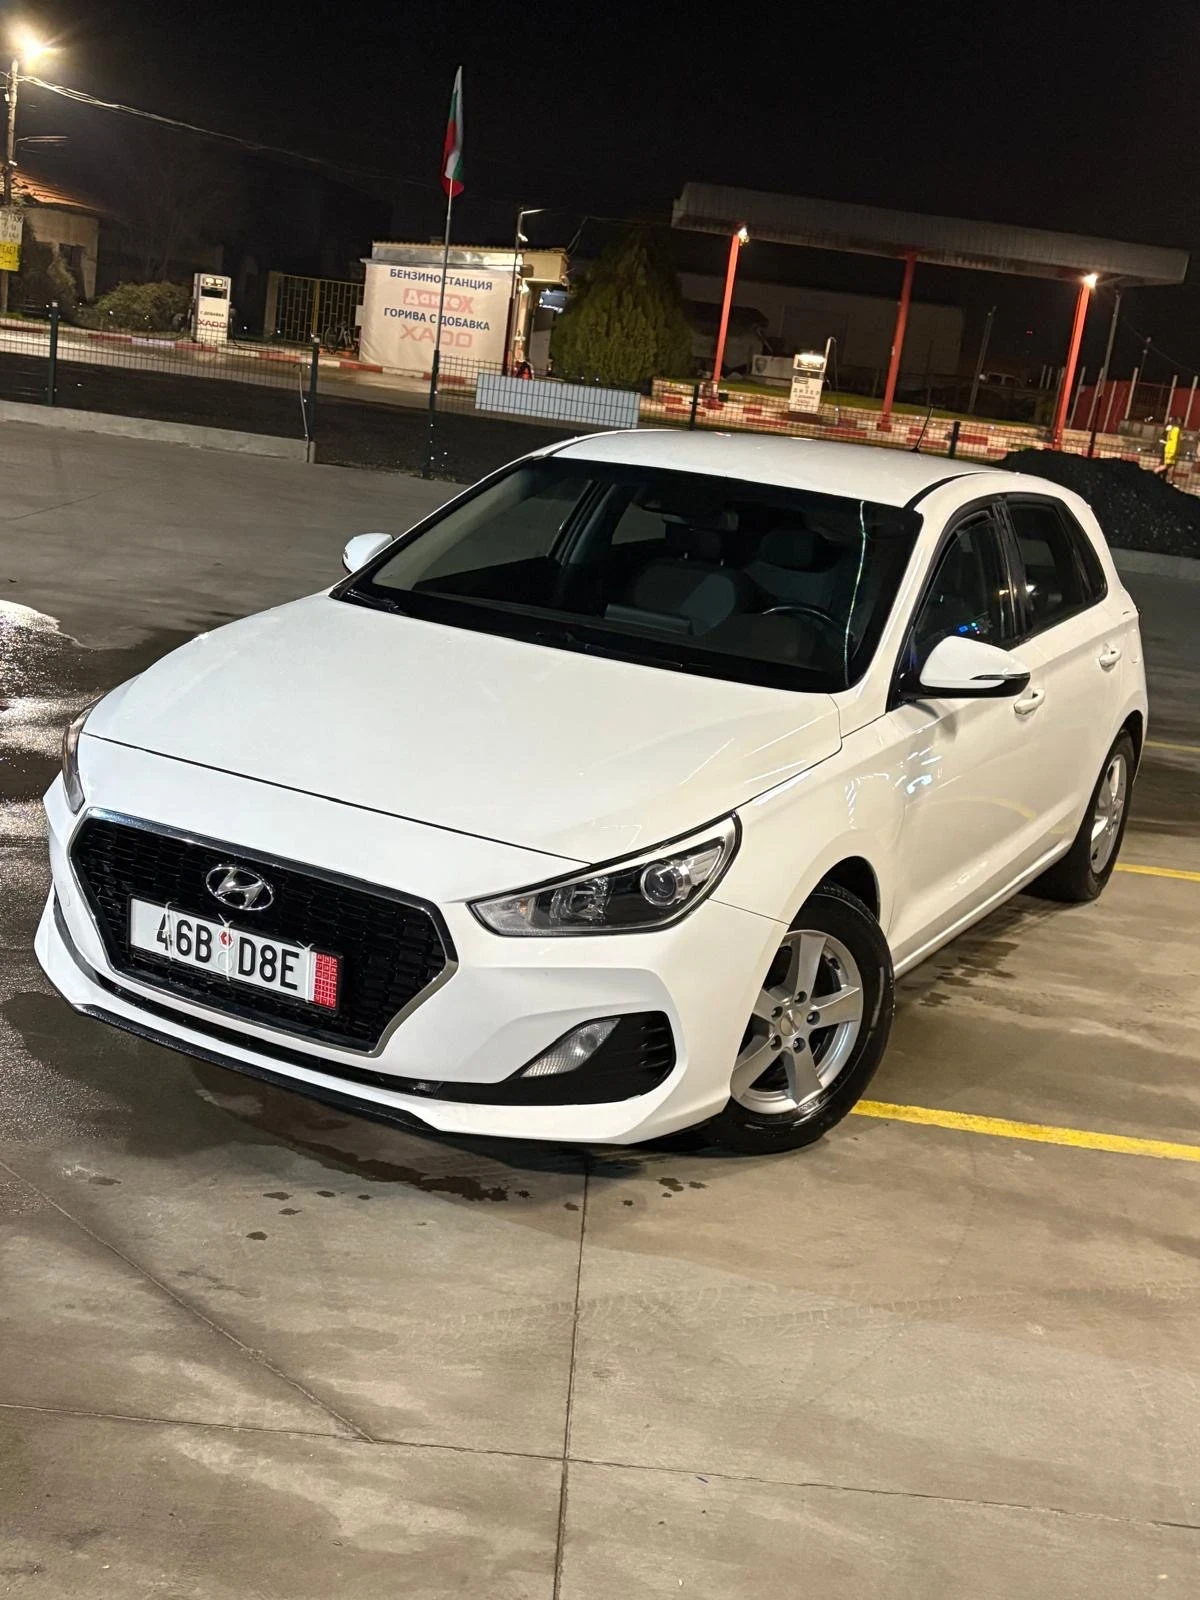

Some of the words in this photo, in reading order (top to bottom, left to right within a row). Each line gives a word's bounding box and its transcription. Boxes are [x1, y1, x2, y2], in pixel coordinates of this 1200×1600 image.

[390, 268, 493, 291] БЕНЗИНОСТАНЦИЯ
[384, 307, 427, 323] ГОРИВА
[429, 314, 437, 324] С
[440, 314, 490, 331] ДОБАВКА
[156, 913, 213, 964] 46B
[238, 936, 300, 991] D8E
